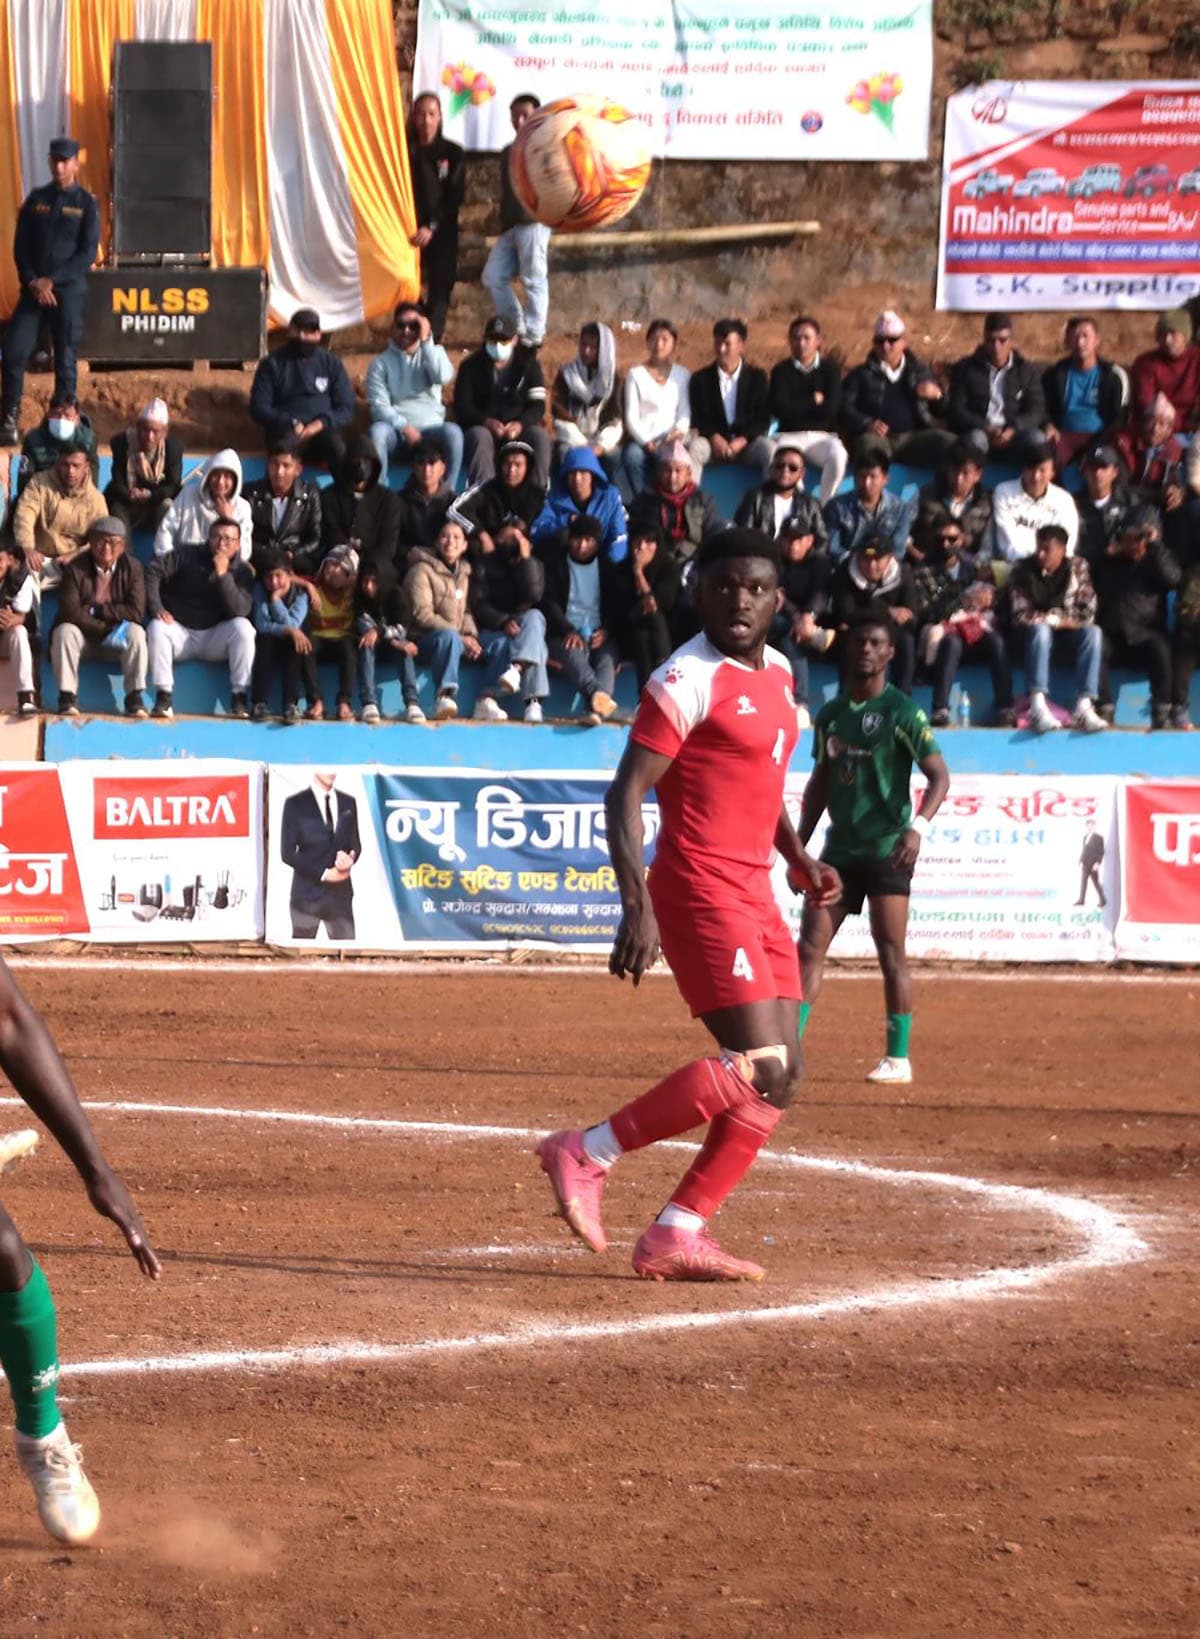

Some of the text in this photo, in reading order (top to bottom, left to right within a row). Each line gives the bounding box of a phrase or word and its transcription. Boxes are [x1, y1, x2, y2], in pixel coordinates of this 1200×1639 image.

[952, 205, 1074, 234] Mahindra
[112, 287, 210, 314] NLSS
[121, 315, 196, 333] PHIDIM
[106, 794, 236, 827] BALTRA
[732, 946, 754, 982] 4
